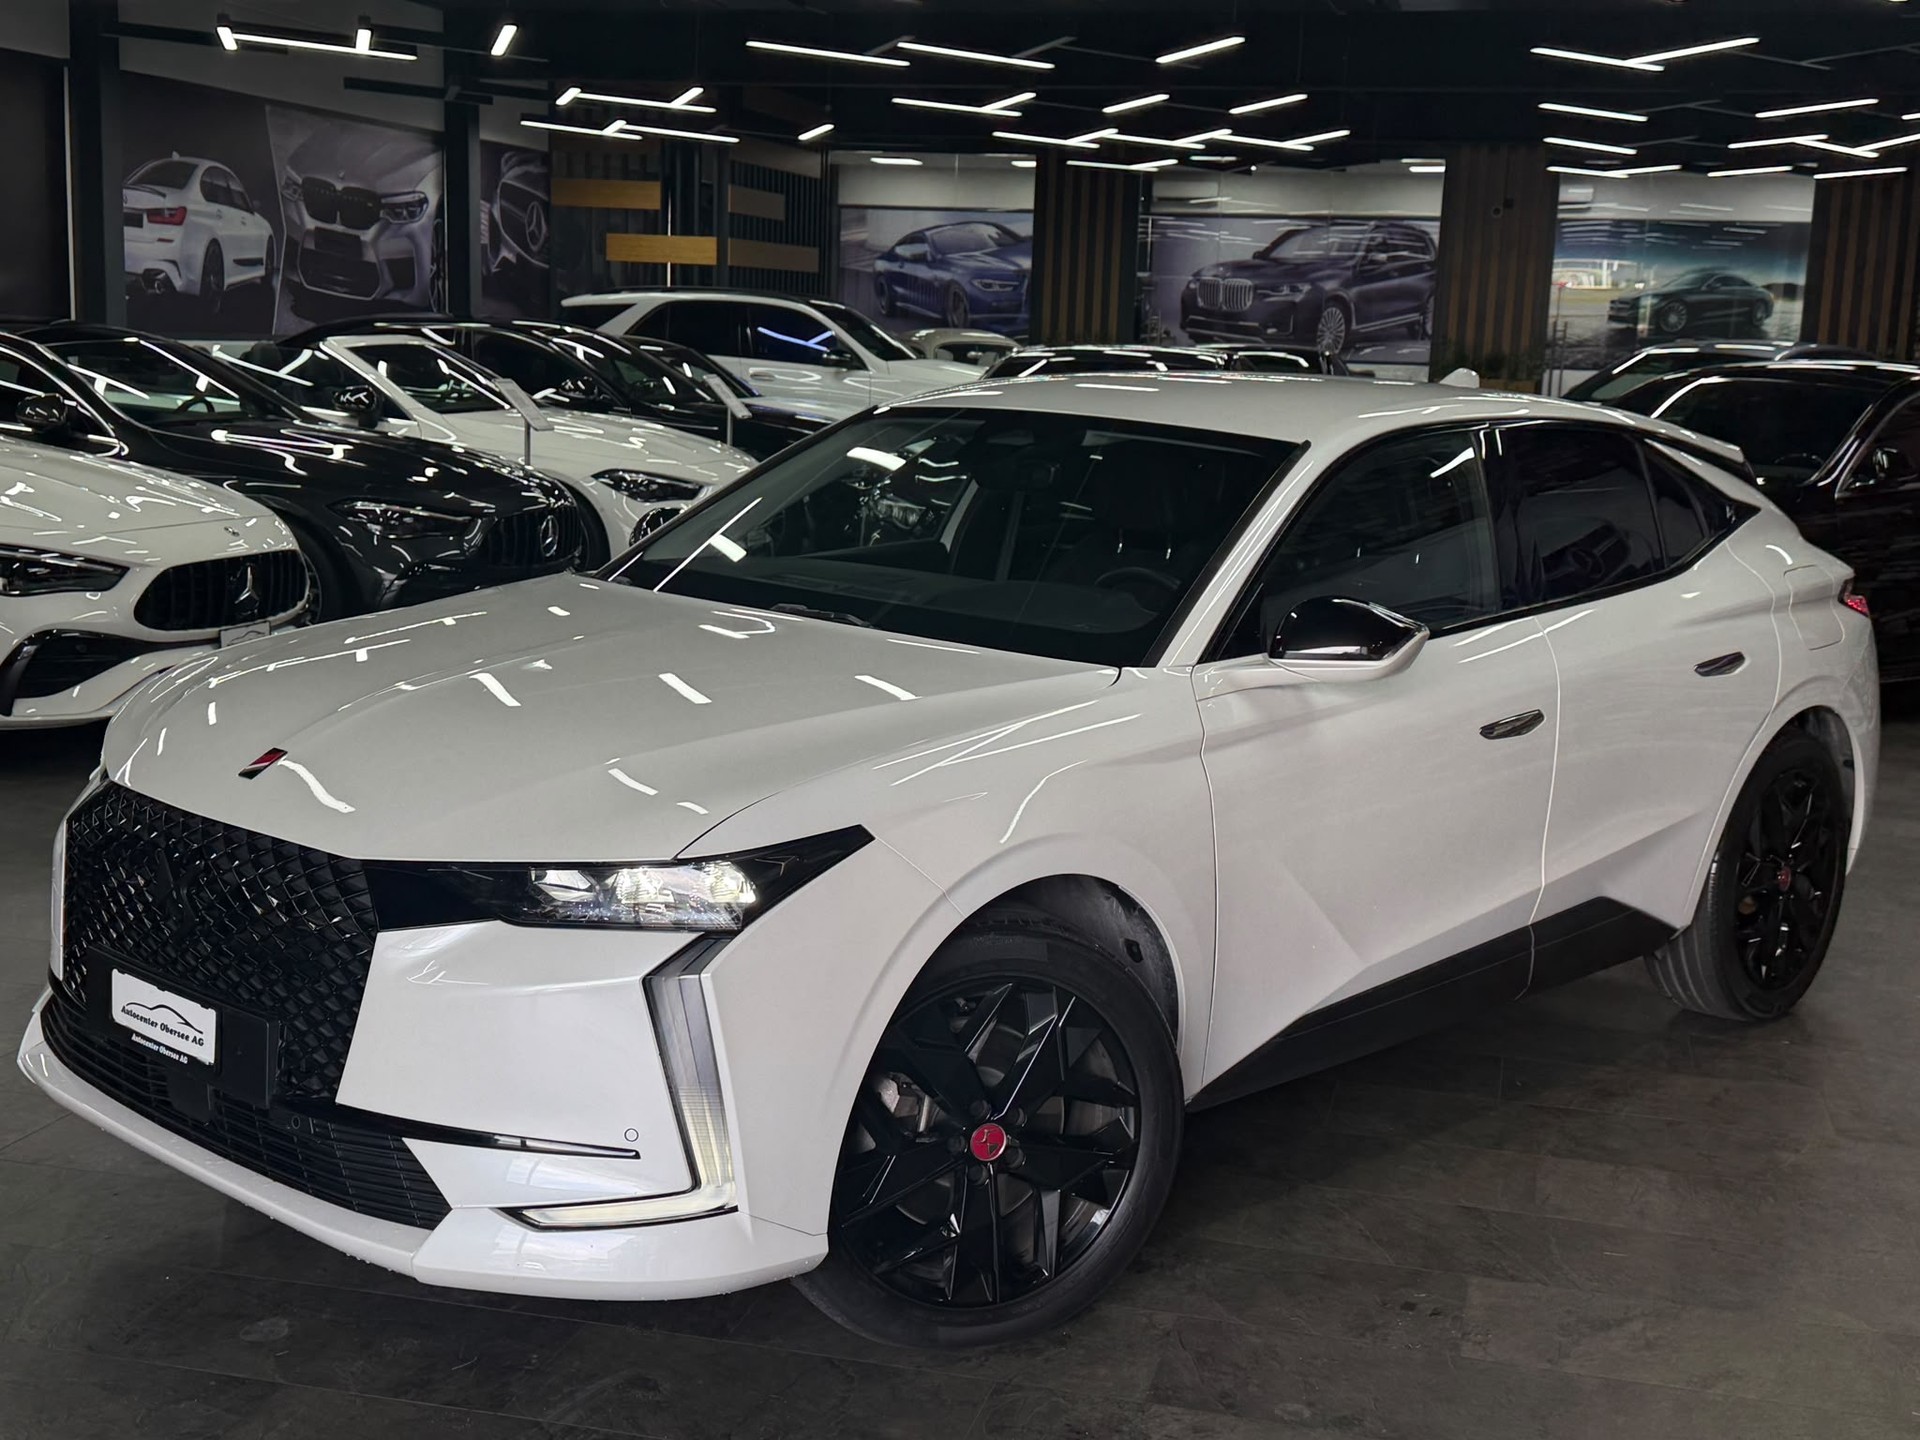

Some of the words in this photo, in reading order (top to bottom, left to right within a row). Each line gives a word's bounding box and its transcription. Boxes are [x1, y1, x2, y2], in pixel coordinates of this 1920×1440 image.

[121, 1005, 158, 1028] Autocenter
[160, 1022, 189, 1042] Obersee
[191, 1035, 204, 1047] AG
[131, 1033, 159, 1051] Autocenter
[159, 1045, 179, 1060] Obersee
[180, 1054, 188, 1064] AG
